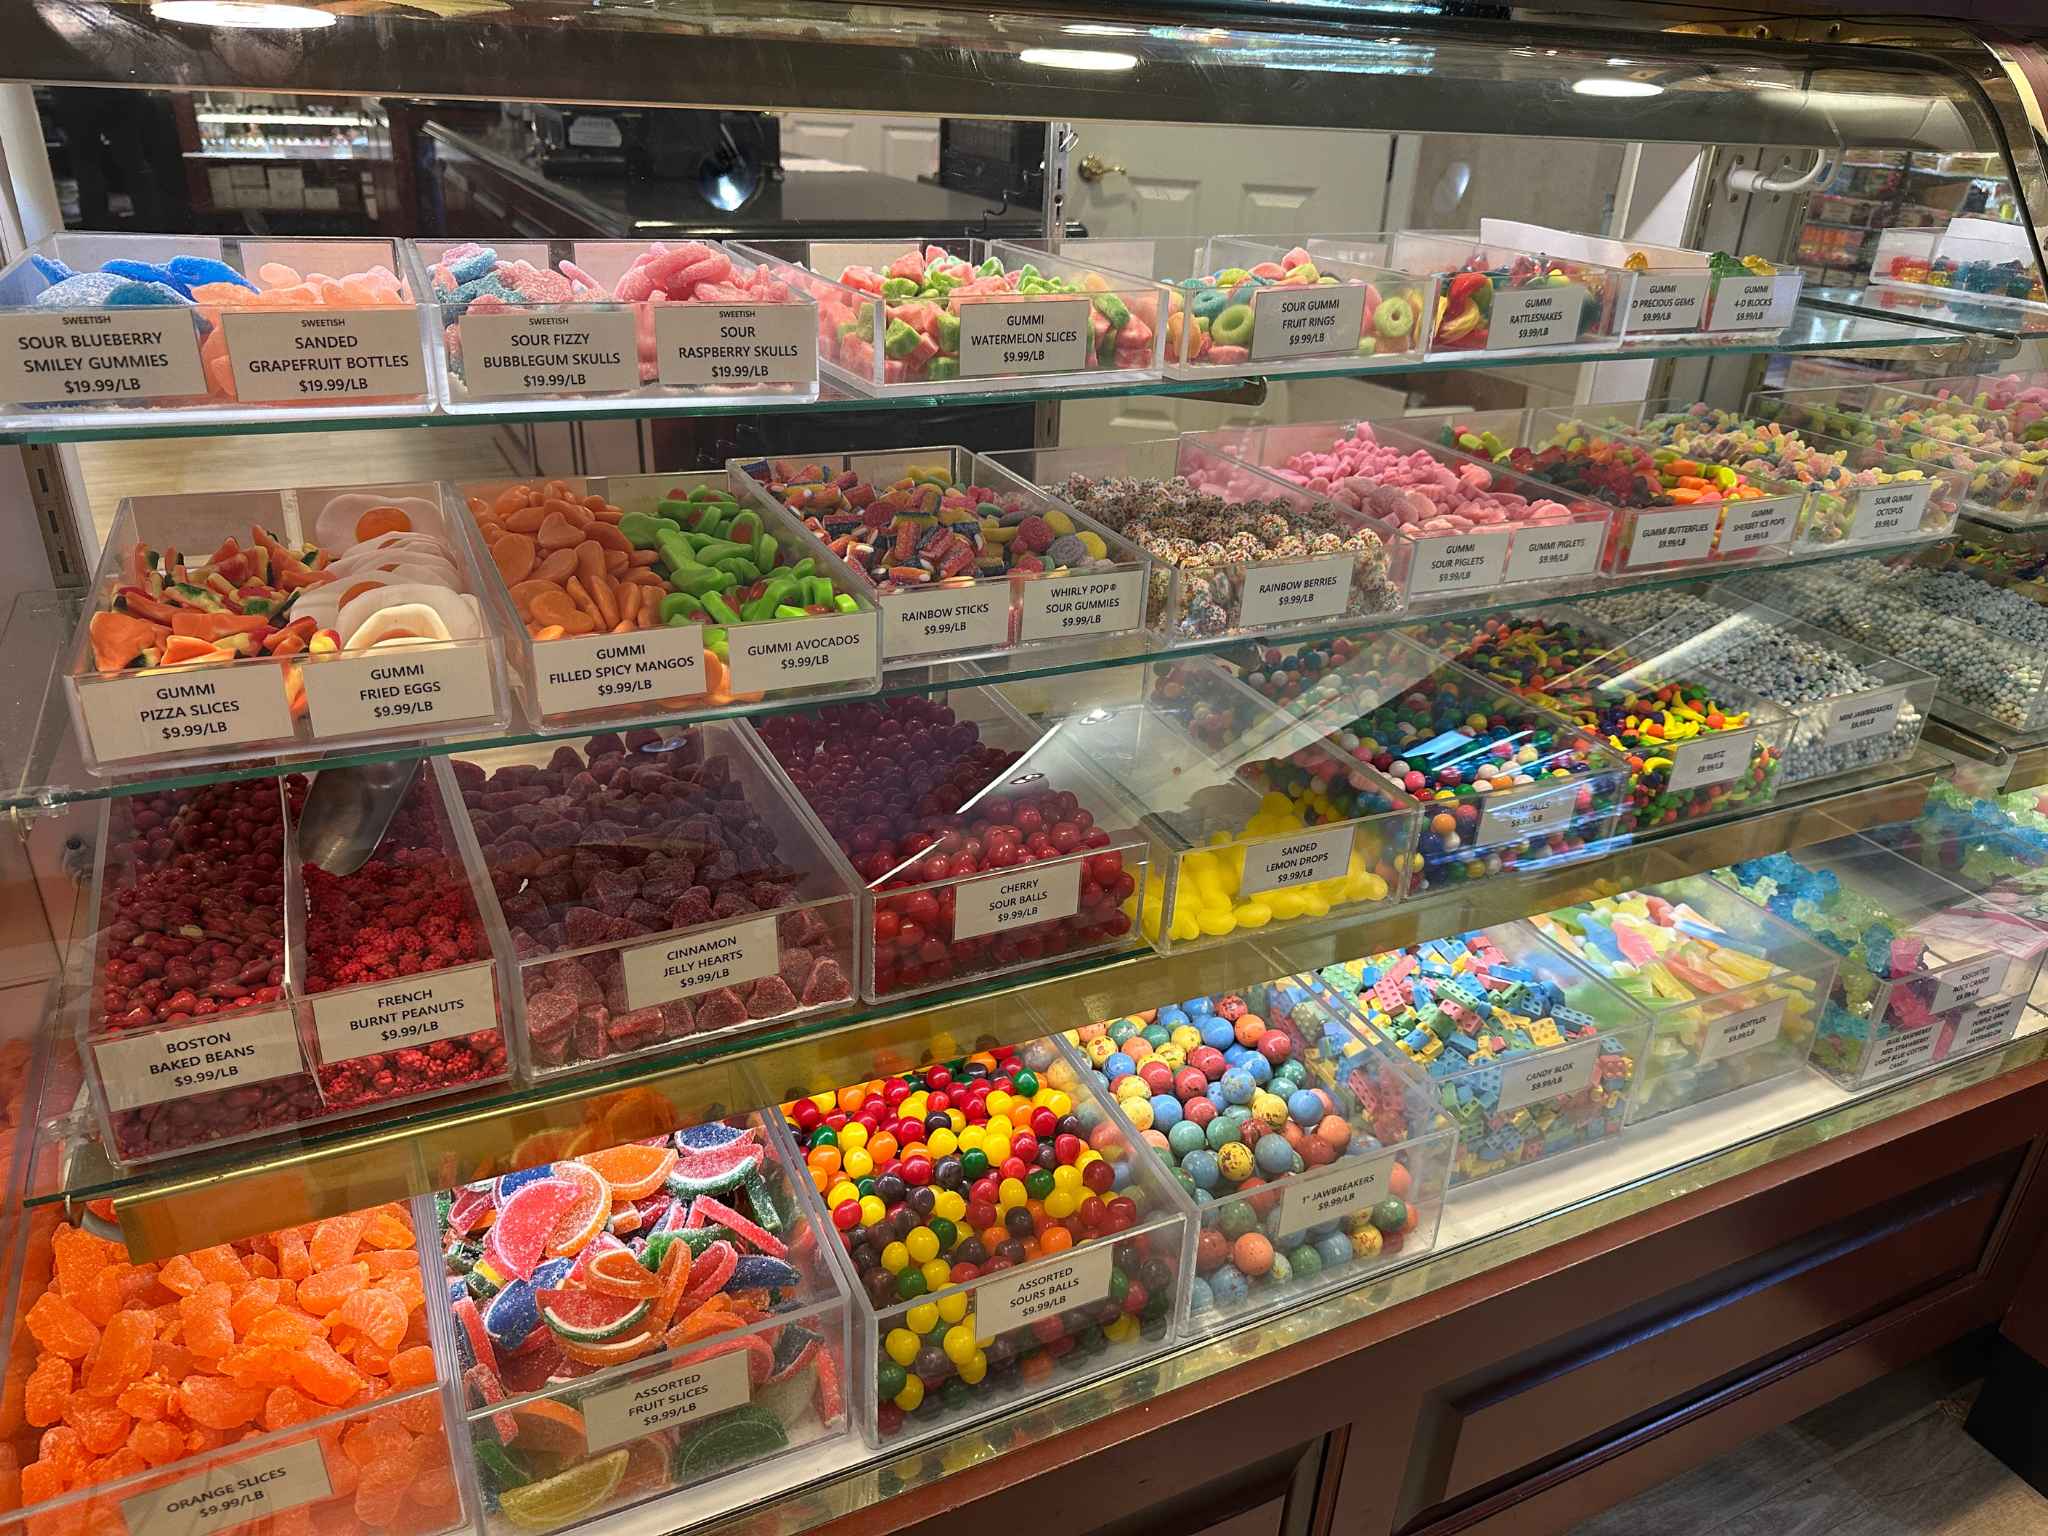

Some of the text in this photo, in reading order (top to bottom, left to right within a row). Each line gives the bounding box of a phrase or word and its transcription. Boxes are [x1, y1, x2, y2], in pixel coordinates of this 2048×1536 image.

[1649, 285, 1677, 294] GUMMI
[1281, 298, 1340, 313] SOUR GUMMI
[1525, 297, 1553, 308] GUMMI
[1640, 298, 1674, 308] PRECIOUS
[1674, 297, 1695, 306] GEMS
[62, 315, 112, 326] SWEETISH
[528, 317, 569, 326] SWEETISH
[719, 310, 756, 319] SWEETISH
[1007, 314, 1044, 326] GUMMI
[1282, 316, 1336, 329] FRUIT RINGS
[1510, 311, 1563, 324] RATTLESNAKES
[301, 318, 346, 328] SWEETISH
[511, 333, 590, 347] SOUR FIZZY
[720, 326, 756, 338] SOUR
[971, 331, 1077, 346] WATERMELON SLICES
[1289, 332, 1325, 346] $9.99/LB
[1518, 327, 1549, 338] $9.99/LB
[18, 331, 163, 350] SOUR BLUEBERRY
[295, 335, 359, 350] SANDED
[678, 344, 798, 359] RASPBERRY SKULLS
[1003, 350, 1045, 363] $9.99/LB
[23, 354, 169, 373] SMILEY GUMMIES
[249, 354, 410, 374] GRAPEFRUIT BOTTLES
[483, 352, 621, 369] BUBBLEGUM SKULLS
[711, 365, 769, 379] $19.99/LB
[64, 378, 141, 394] $19.99/LB
[299, 378, 369, 393] $19.99/LB
[523, 373, 587, 388] $19.99/LB
[1446, 543, 1475, 554] GUMMI
[1529, 538, 1585, 552] GUMMI PIGLETS
[1431, 556, 1484, 569] SOUR PIGLETS
[1051, 585, 1088, 598] WHIRLY
[1259, 576, 1337, 593] RAINBOW BERRIES
[1046, 598, 1120, 613] SOUR GUMMIES
[1278, 594, 1314, 606] $9.99/LB
[901, 603, 989, 623] RAINBOW STICKS
[1062, 614, 1102, 628] $9.99/LB
[924, 622, 967, 636] $9.99/LB
[596, 644, 646, 660] GUMMI
[748, 634, 860, 657] GUMMI AVOCADOS
[781, 654, 830, 670] $9.99/LB
[370, 664, 425, 681] GUMMI
[550, 656, 694, 685] FILLED SPICY MANGOS
[156, 683, 216, 701] GUMMI
[359, 681, 441, 701] FRIED EGGS
[598, 679, 652, 697] $9.99/LB
[140, 700, 240, 722] PIZZA SLICES
[374, 701, 433, 718] $9.99/LB
[162, 721, 228, 740] $9.99/LB
[1281, 842, 1318, 857] SANDED
[1266, 852, 1329, 873] LEMON DROPS
[1278, 868, 1313, 883] $9.99/LB
[1000, 879, 1040, 895] CHERRY
[989, 891, 1048, 911] SOUR BALLS
[998, 907, 1038, 923] $9.99/LB
[667, 936, 737, 961] CINNAMON
[663, 950, 743, 978] JELLY HEARTS
[680, 968, 730, 988] $9.99/LB
[377, 989, 434, 1009] FRENCH
[350, 1000, 465, 1031] BURNT PEANUTS
[381, 1021, 439, 1042] $9.99/LB
[166, 1031, 232, 1054] BOSTON
[149, 1046, 256, 1075] BAKED BEANS
[174, 1065, 240, 1088] $9.99/LB
[1526, 1067, 1553, 1082] CANDY
[1311, 1174, 1376, 1201] JAWBREAKERS
[1318, 1192, 1355, 1211] $9.99/LB
[1018, 1267, 1073, 1293] ASSORTED
[1009, 1278, 1080, 1309] SOURS BALLS
[1022, 1295, 1066, 1317] $9.99/LB
[634, 1373, 701, 1401] ASSORTED
[628, 1384, 710, 1417] FRUIT SLICES
[643, 1402, 697, 1426] $9.99/LB
[166, 1466, 287, 1513] ORANGE SLICES
[200, 1490, 265, 1518] $9.99/LB
